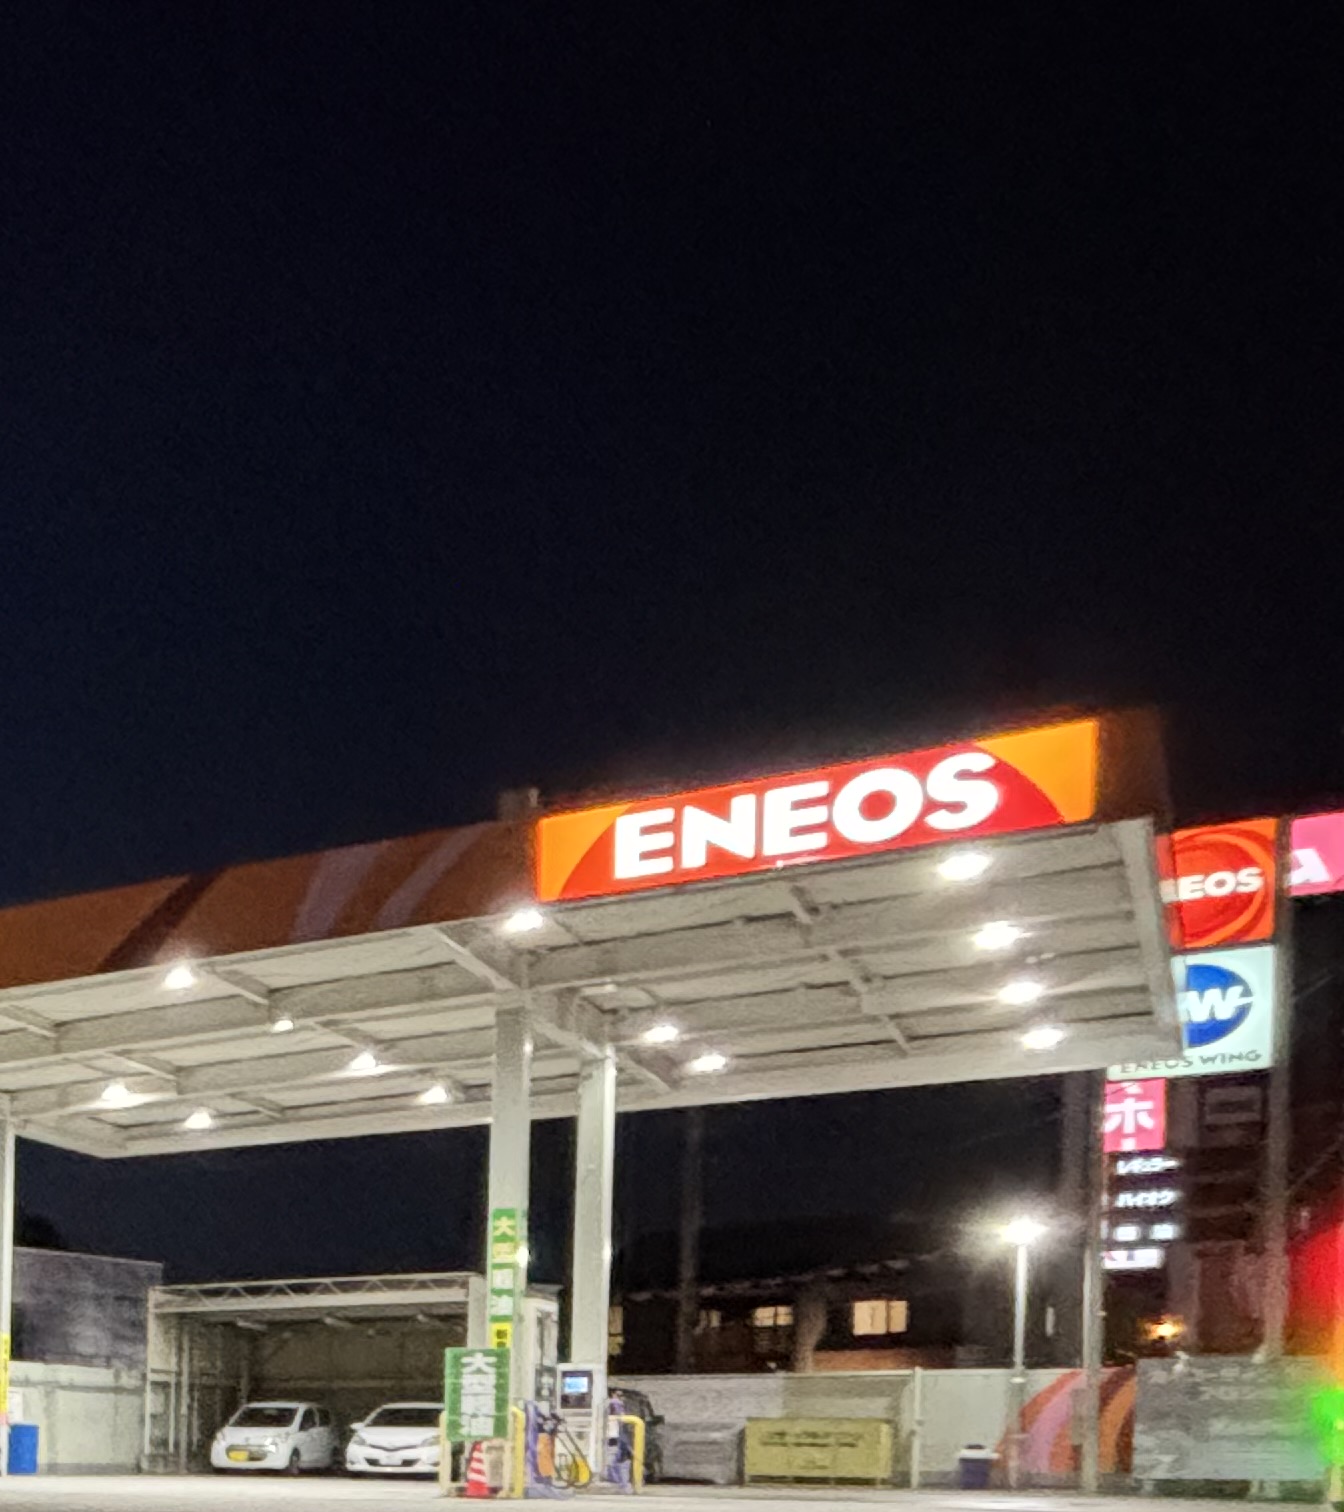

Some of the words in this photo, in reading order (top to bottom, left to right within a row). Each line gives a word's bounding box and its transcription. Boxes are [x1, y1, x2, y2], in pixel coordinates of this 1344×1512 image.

[613, 751, 1000, 880] ENEOS
[1160, 866, 1264, 904] EOS
[1199, 1049, 1263, 1066] WING
